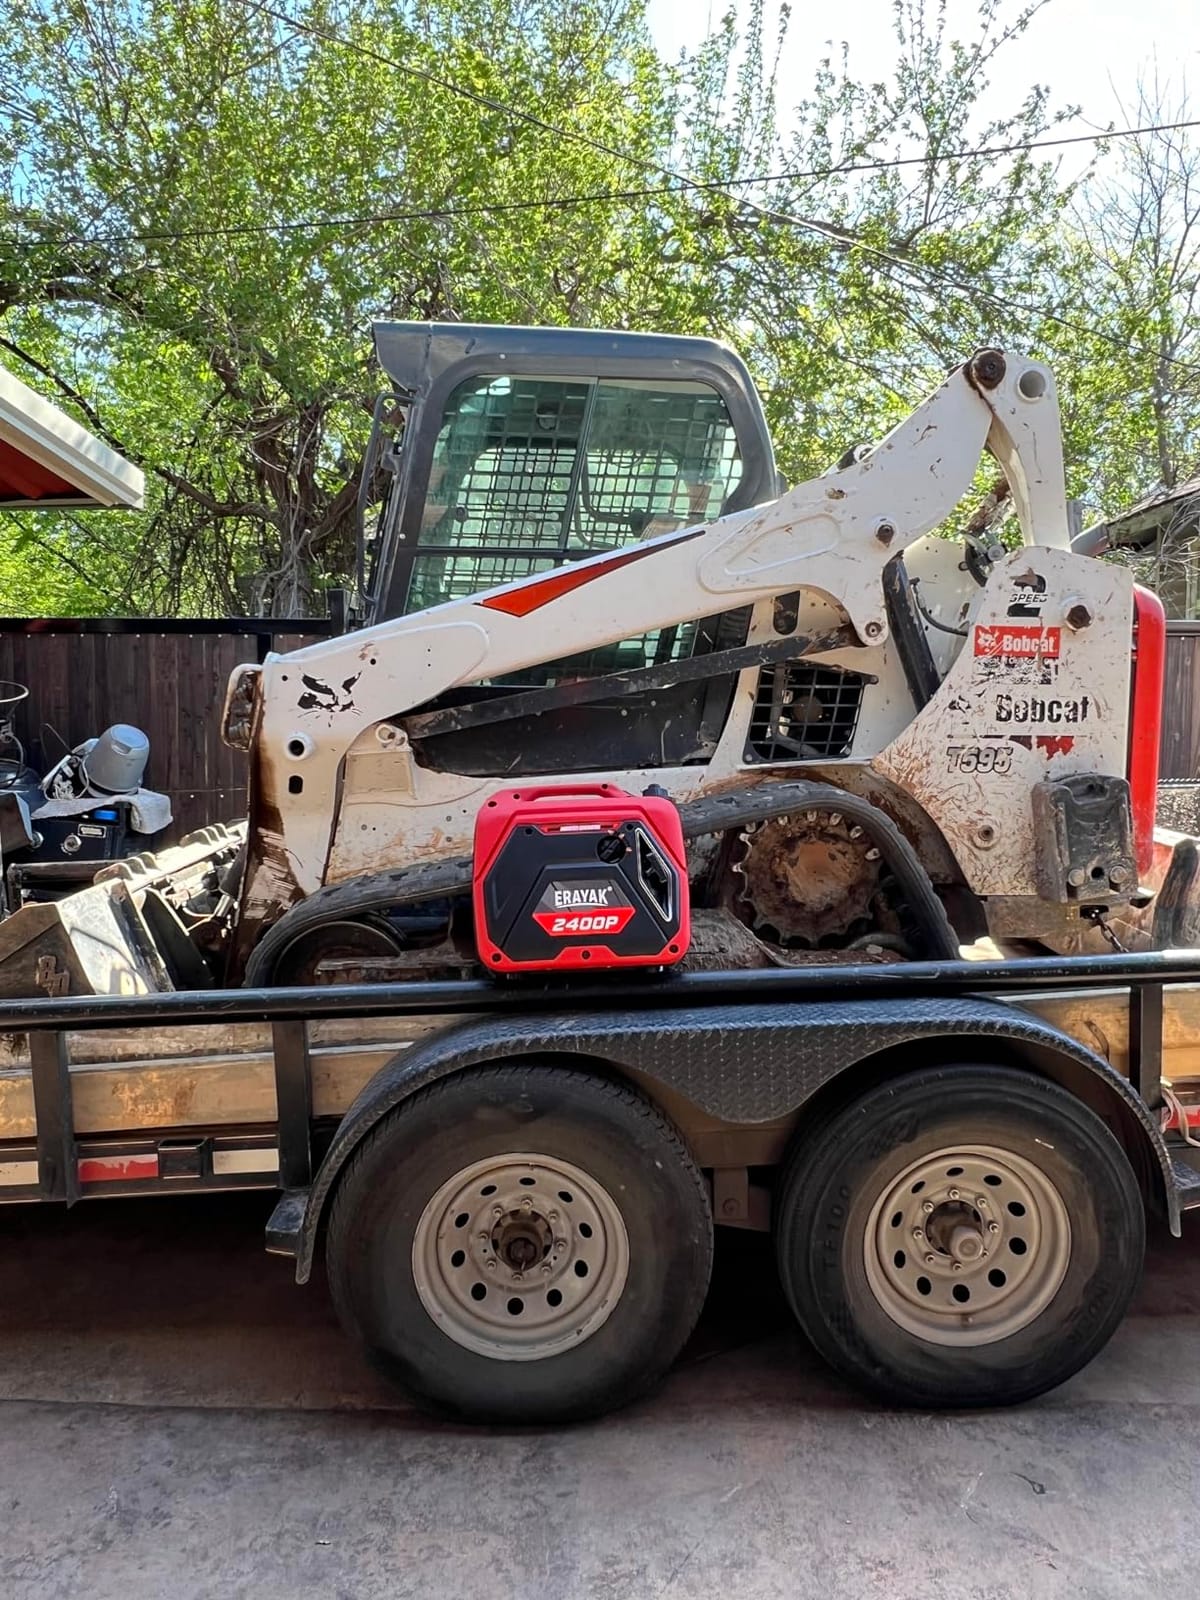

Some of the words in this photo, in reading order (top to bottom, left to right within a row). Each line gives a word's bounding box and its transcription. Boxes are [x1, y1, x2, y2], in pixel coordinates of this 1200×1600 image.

[1009, 593, 1048, 603] SPEED
[1002, 635, 1055, 653] Bobcat
[996, 694, 1089, 723] Bobcat
[554, 888, 608, 908] ERAYAK
[552, 916, 619, 932] 2400P
